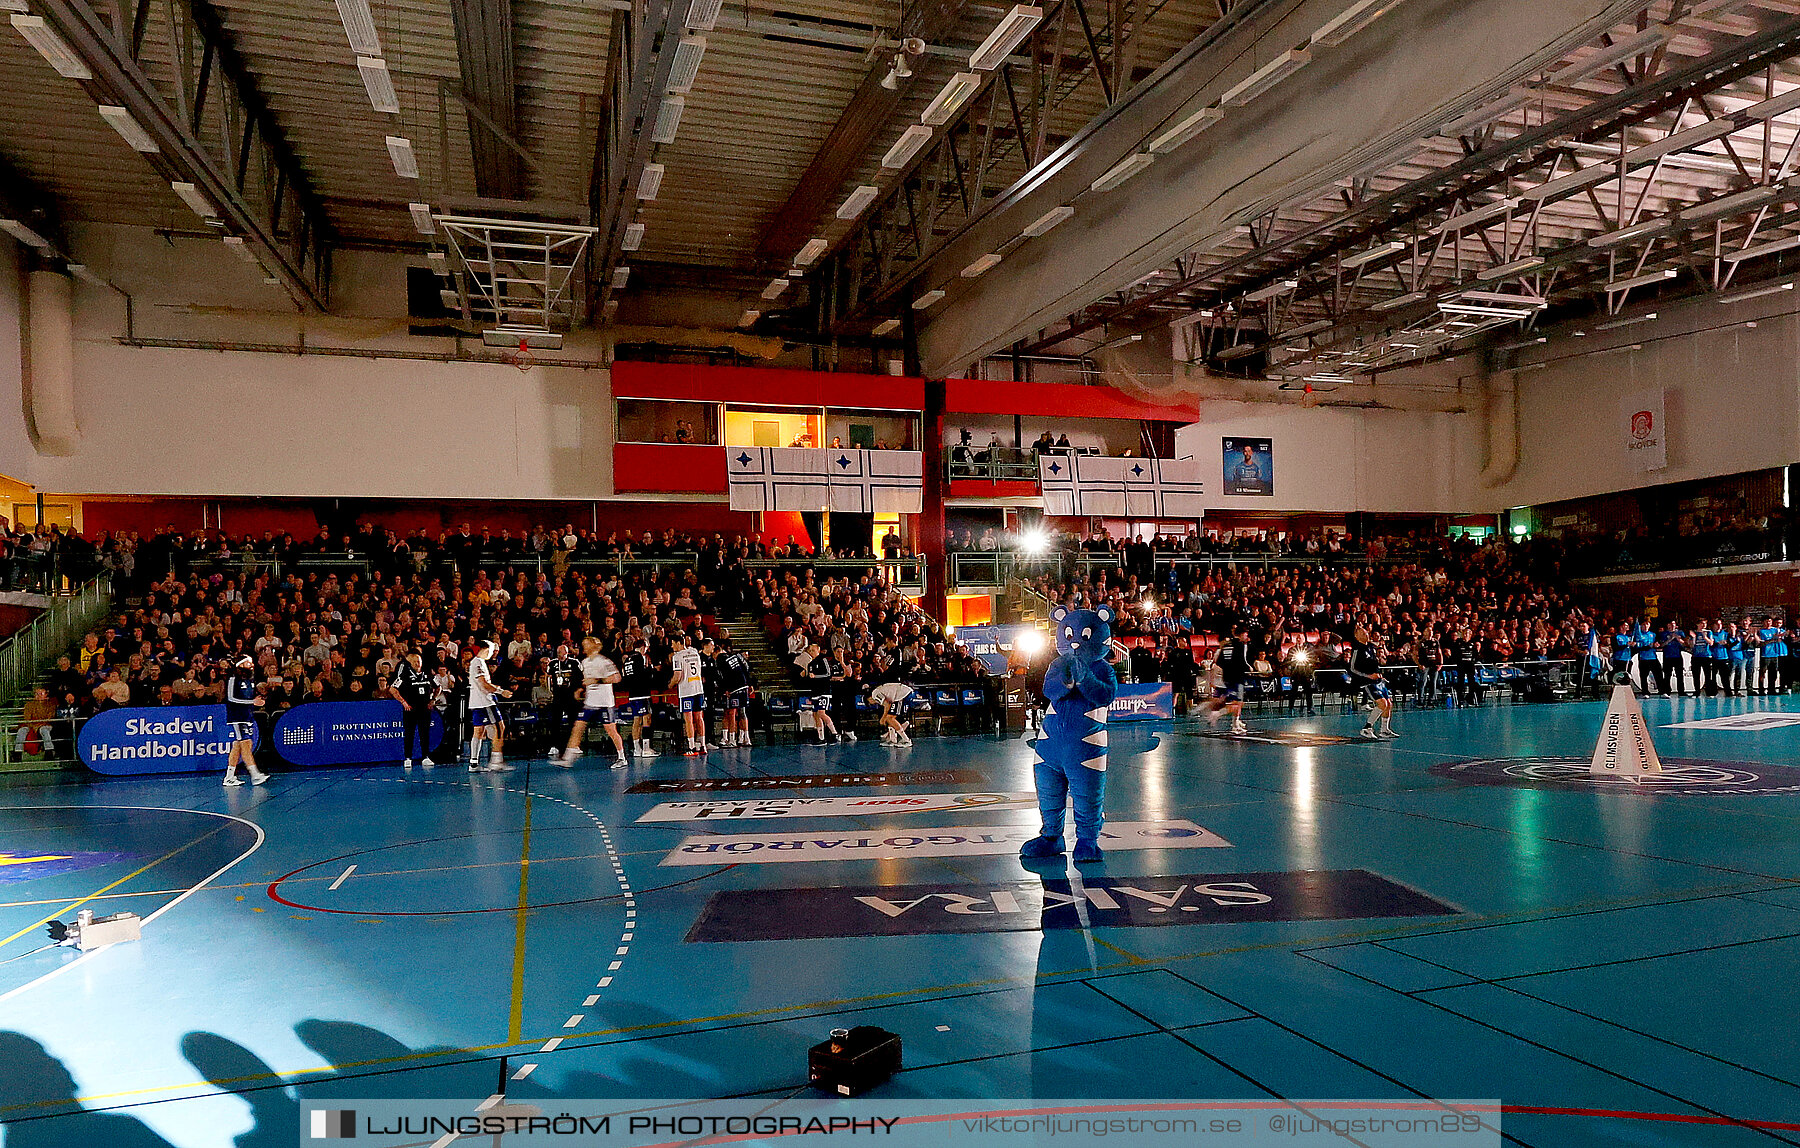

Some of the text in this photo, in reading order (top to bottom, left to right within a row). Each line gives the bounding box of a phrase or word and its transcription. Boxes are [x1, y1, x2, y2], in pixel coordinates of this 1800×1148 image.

[688, 662, 697, 675] 5
[818, 698, 827, 706] 20
[1008, 695, 1019, 703] EY
[125, 716, 213, 736] Skadevi
[332, 721, 389, 731] DROTTNING
[332, 731, 405, 741] GYMNASIESKOL
[91, 739, 231, 761] Handbollscu
[694, 805, 792, 819] SH
[853, 882, 1273, 918] SÄKRA
